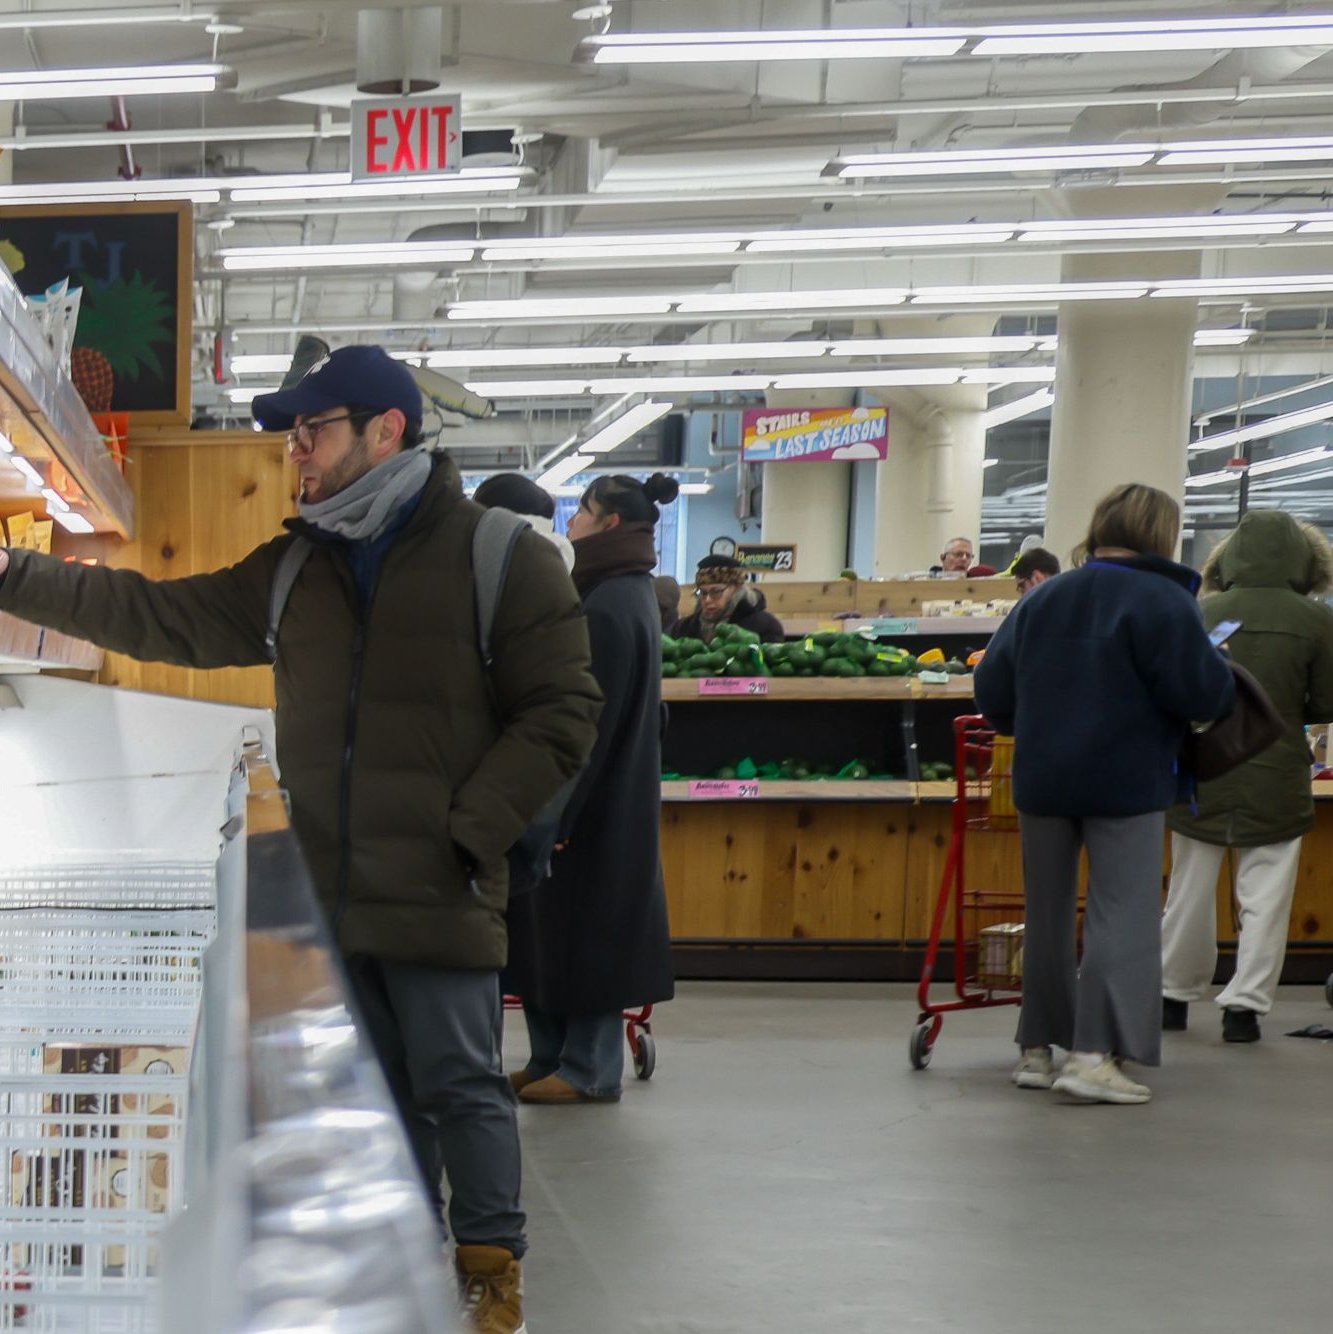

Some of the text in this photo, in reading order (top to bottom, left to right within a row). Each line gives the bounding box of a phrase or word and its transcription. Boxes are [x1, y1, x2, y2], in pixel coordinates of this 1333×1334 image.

[367, 106, 453, 173] EXIT
[756, 411, 810, 435] STAIRS
[775, 416, 887, 459] LAST SEASON
[774, 551, 793, 570] 23
